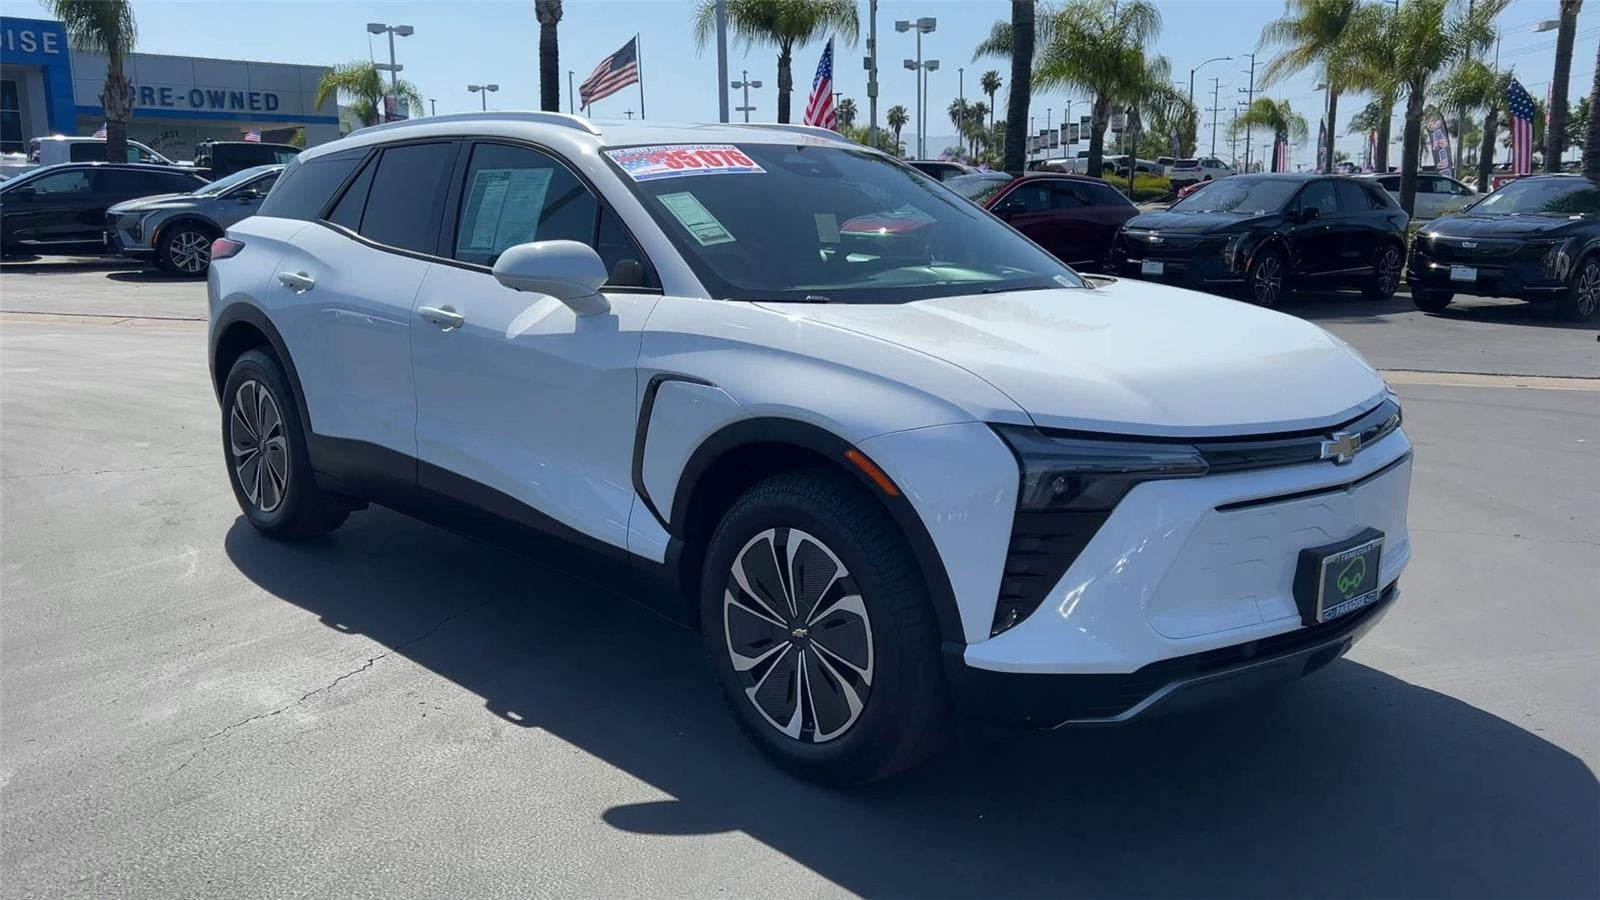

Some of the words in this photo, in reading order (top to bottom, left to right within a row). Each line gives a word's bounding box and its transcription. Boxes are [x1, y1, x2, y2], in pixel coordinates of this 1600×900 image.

[0, 30, 59, 54] ISE
[128, 87, 279, 111] PRE-OWNED
[1336, 597, 1366, 615] PARADISE
